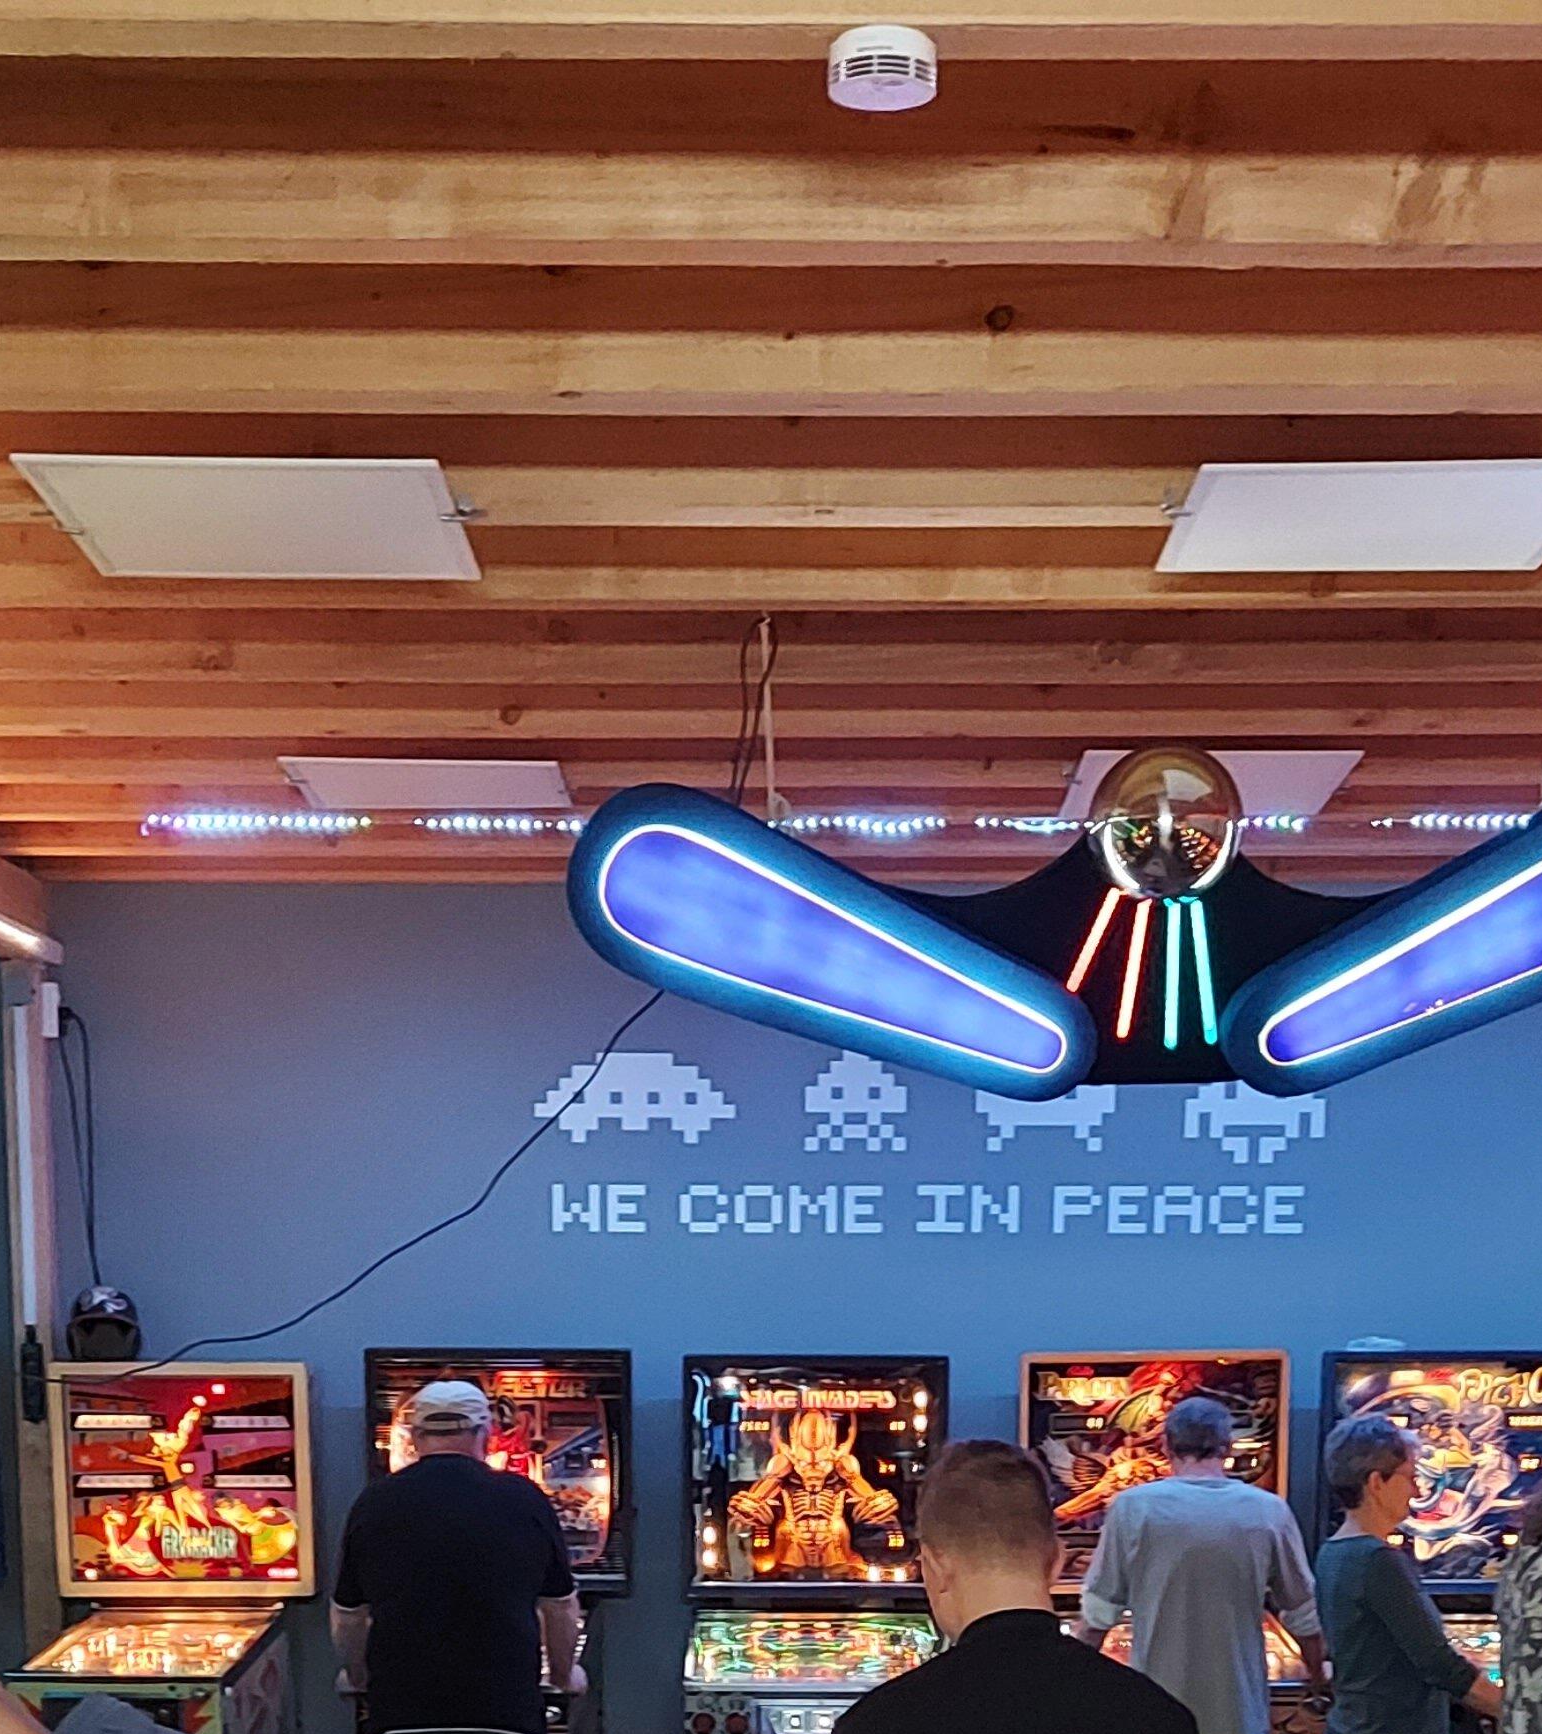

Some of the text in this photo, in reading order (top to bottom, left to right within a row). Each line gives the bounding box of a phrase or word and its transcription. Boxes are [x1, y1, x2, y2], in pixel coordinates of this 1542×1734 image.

[552, 1184, 1304, 1234] WE COME IN PEACE
[739, 1389, 897, 1409] SPACE INVADERS
